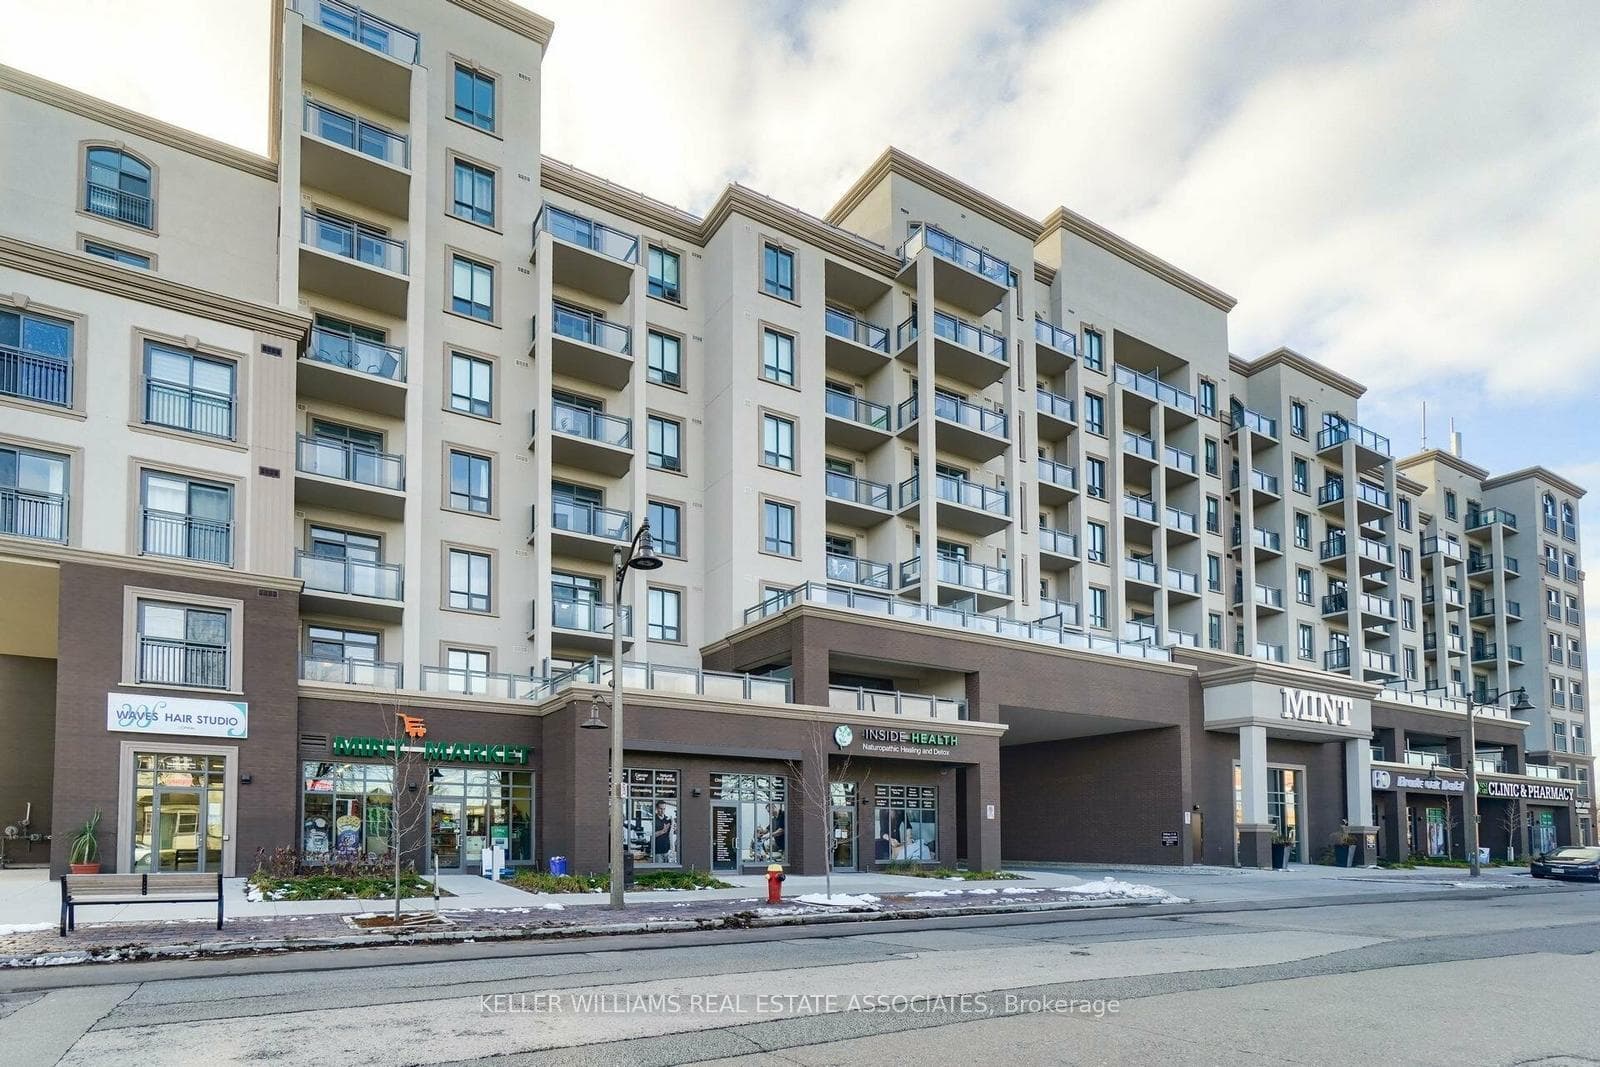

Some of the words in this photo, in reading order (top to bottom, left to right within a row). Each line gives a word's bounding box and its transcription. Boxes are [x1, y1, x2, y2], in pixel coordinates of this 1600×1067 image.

[1280, 688, 1353, 726] MINT
[116, 710, 159, 721] WAVES
[165, 713, 193, 724] HAIR
[197, 715, 239, 726] STUDIO
[864, 729, 907, 743] INSIDE
[911, 732, 959, 746] HEALTH
[423, 741, 533, 764] MARKET
[862, 743, 900, 753] Naturopathic
[900, 745, 921, 756] Healing
[922, 747, 933, 756] and
[933, 748, 950, 757] Detox
[1488, 781, 1520, 797] CLINIC
[1520, 785, 1527, 797] &
[1527, 785, 1574, 800] PHARMACY
